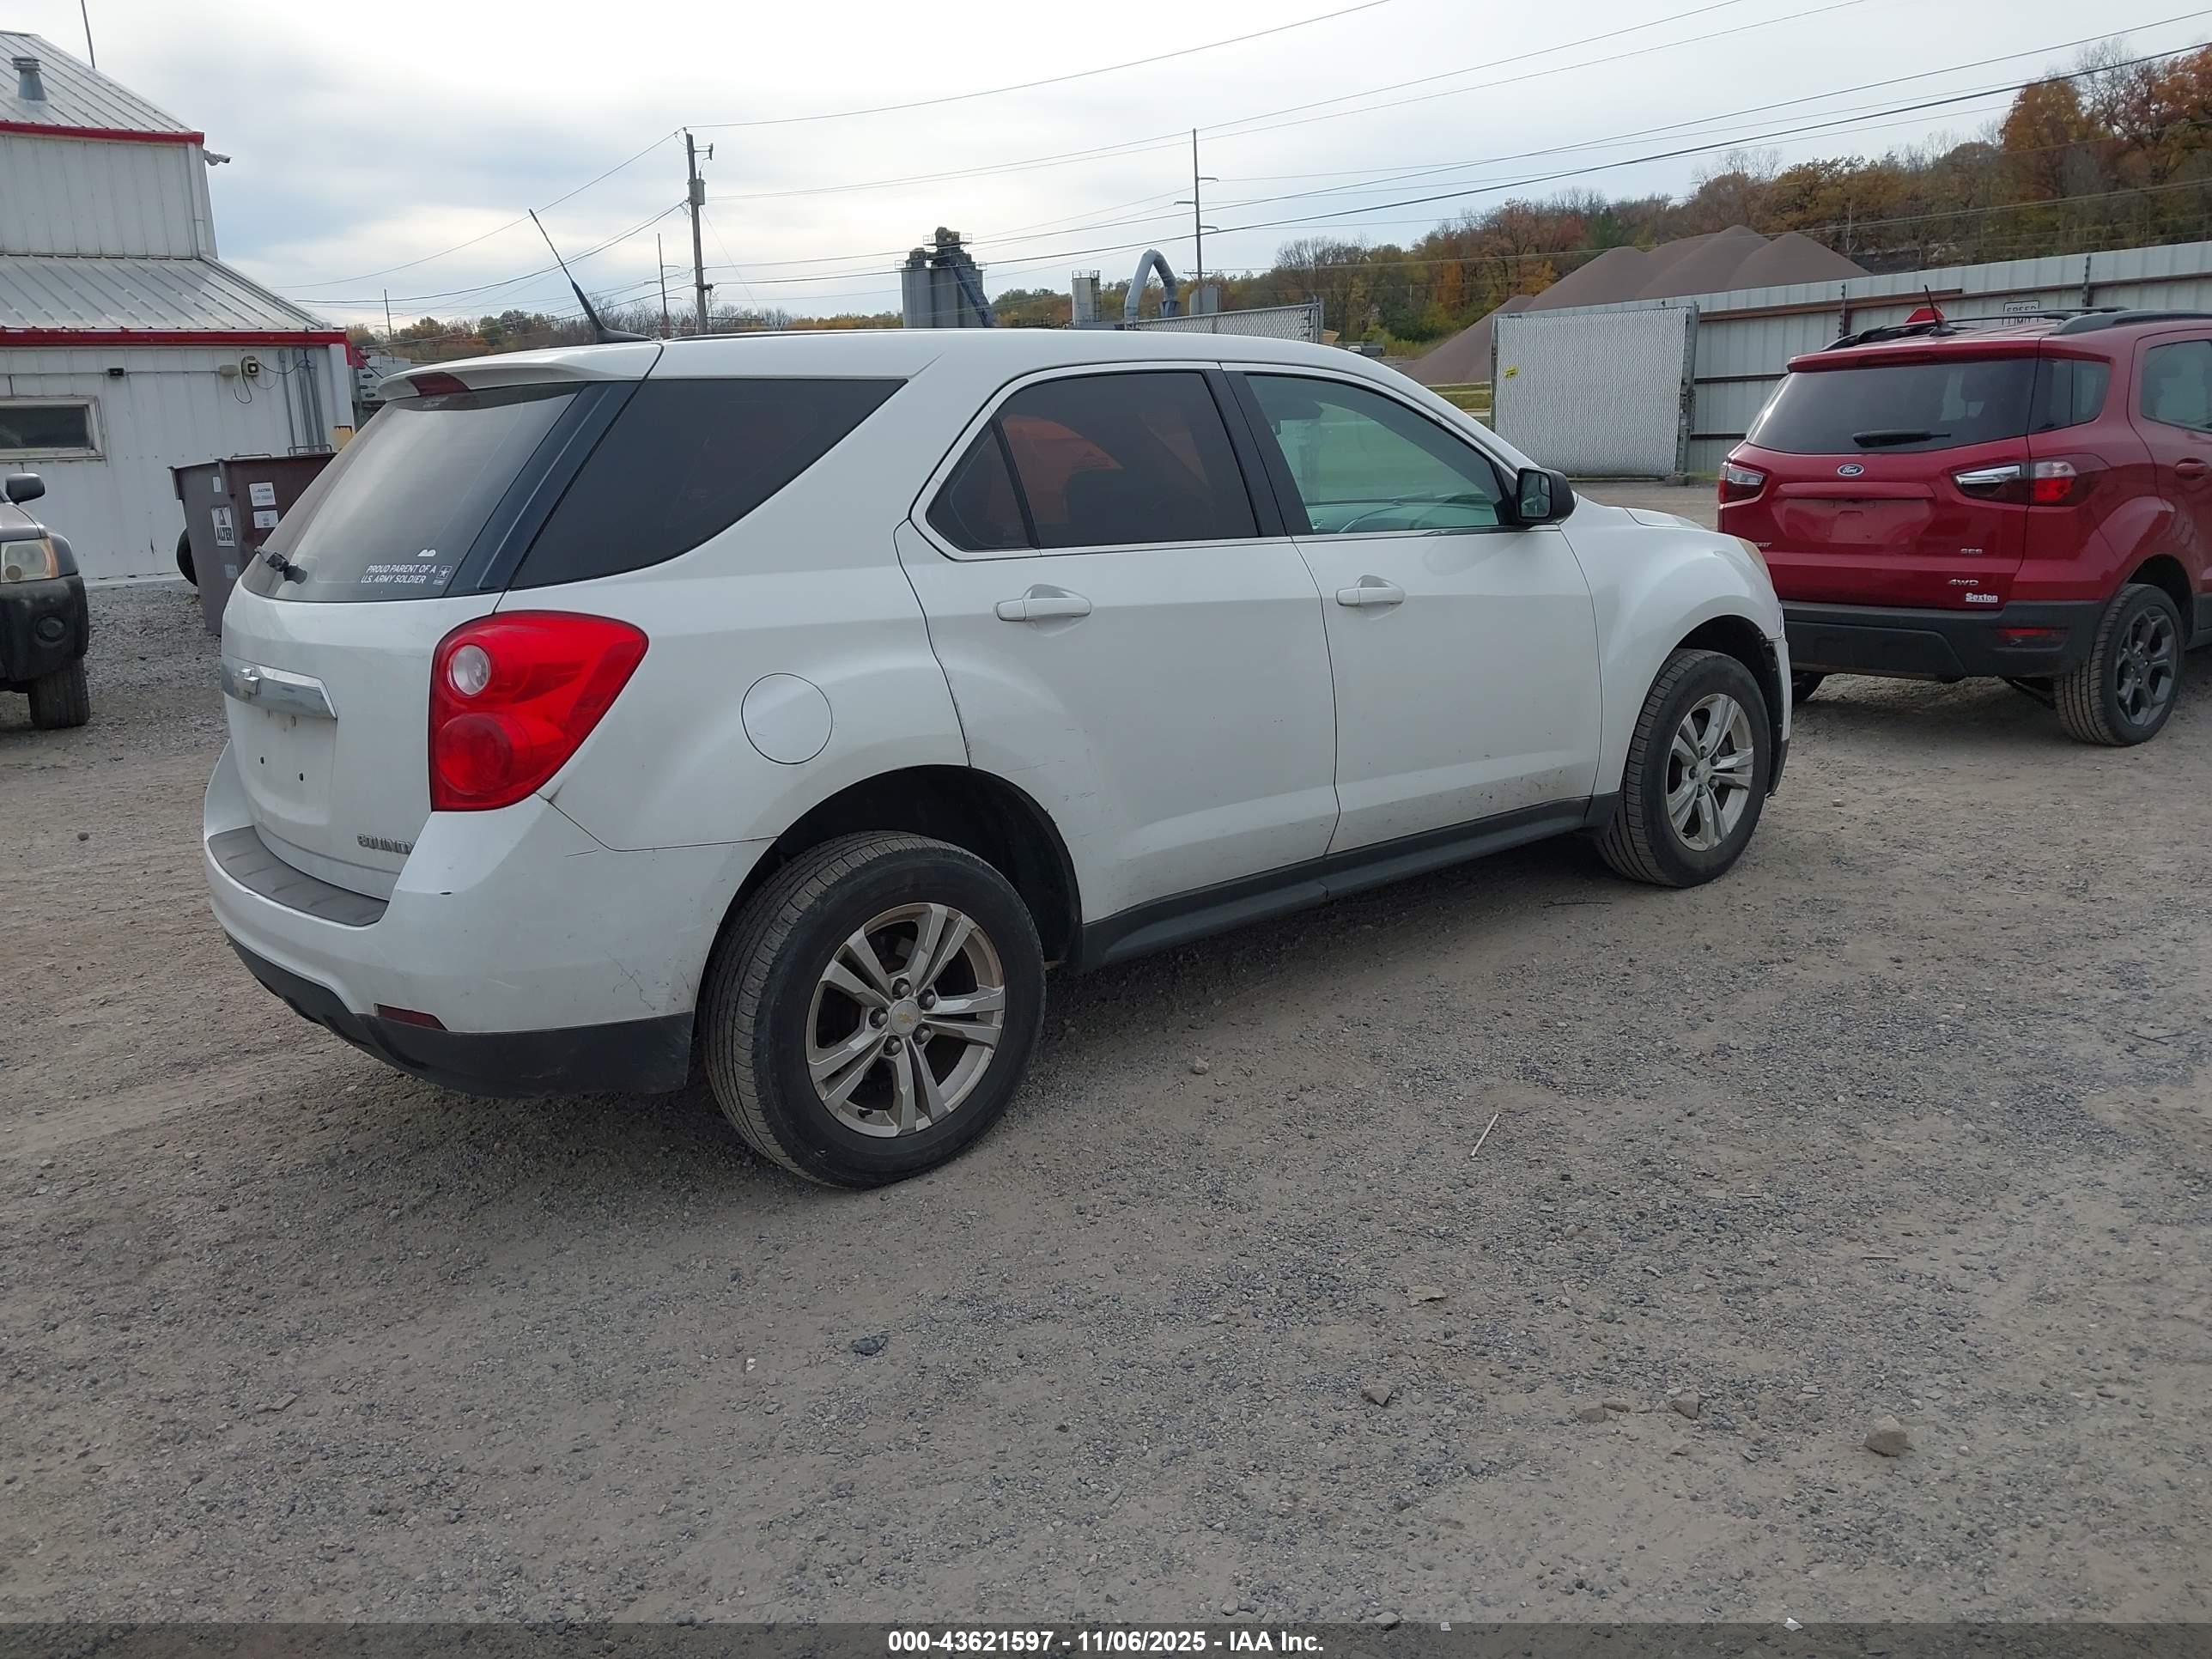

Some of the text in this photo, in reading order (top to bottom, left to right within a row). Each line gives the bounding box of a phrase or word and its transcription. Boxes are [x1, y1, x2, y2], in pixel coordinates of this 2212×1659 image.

[366, 564, 437, 574] PROUD PARENT OF A
[373, 574, 395, 583] ARMY
[394, 574, 427, 584] SOLDIER
[1966, 592, 1998, 602] Sexton
